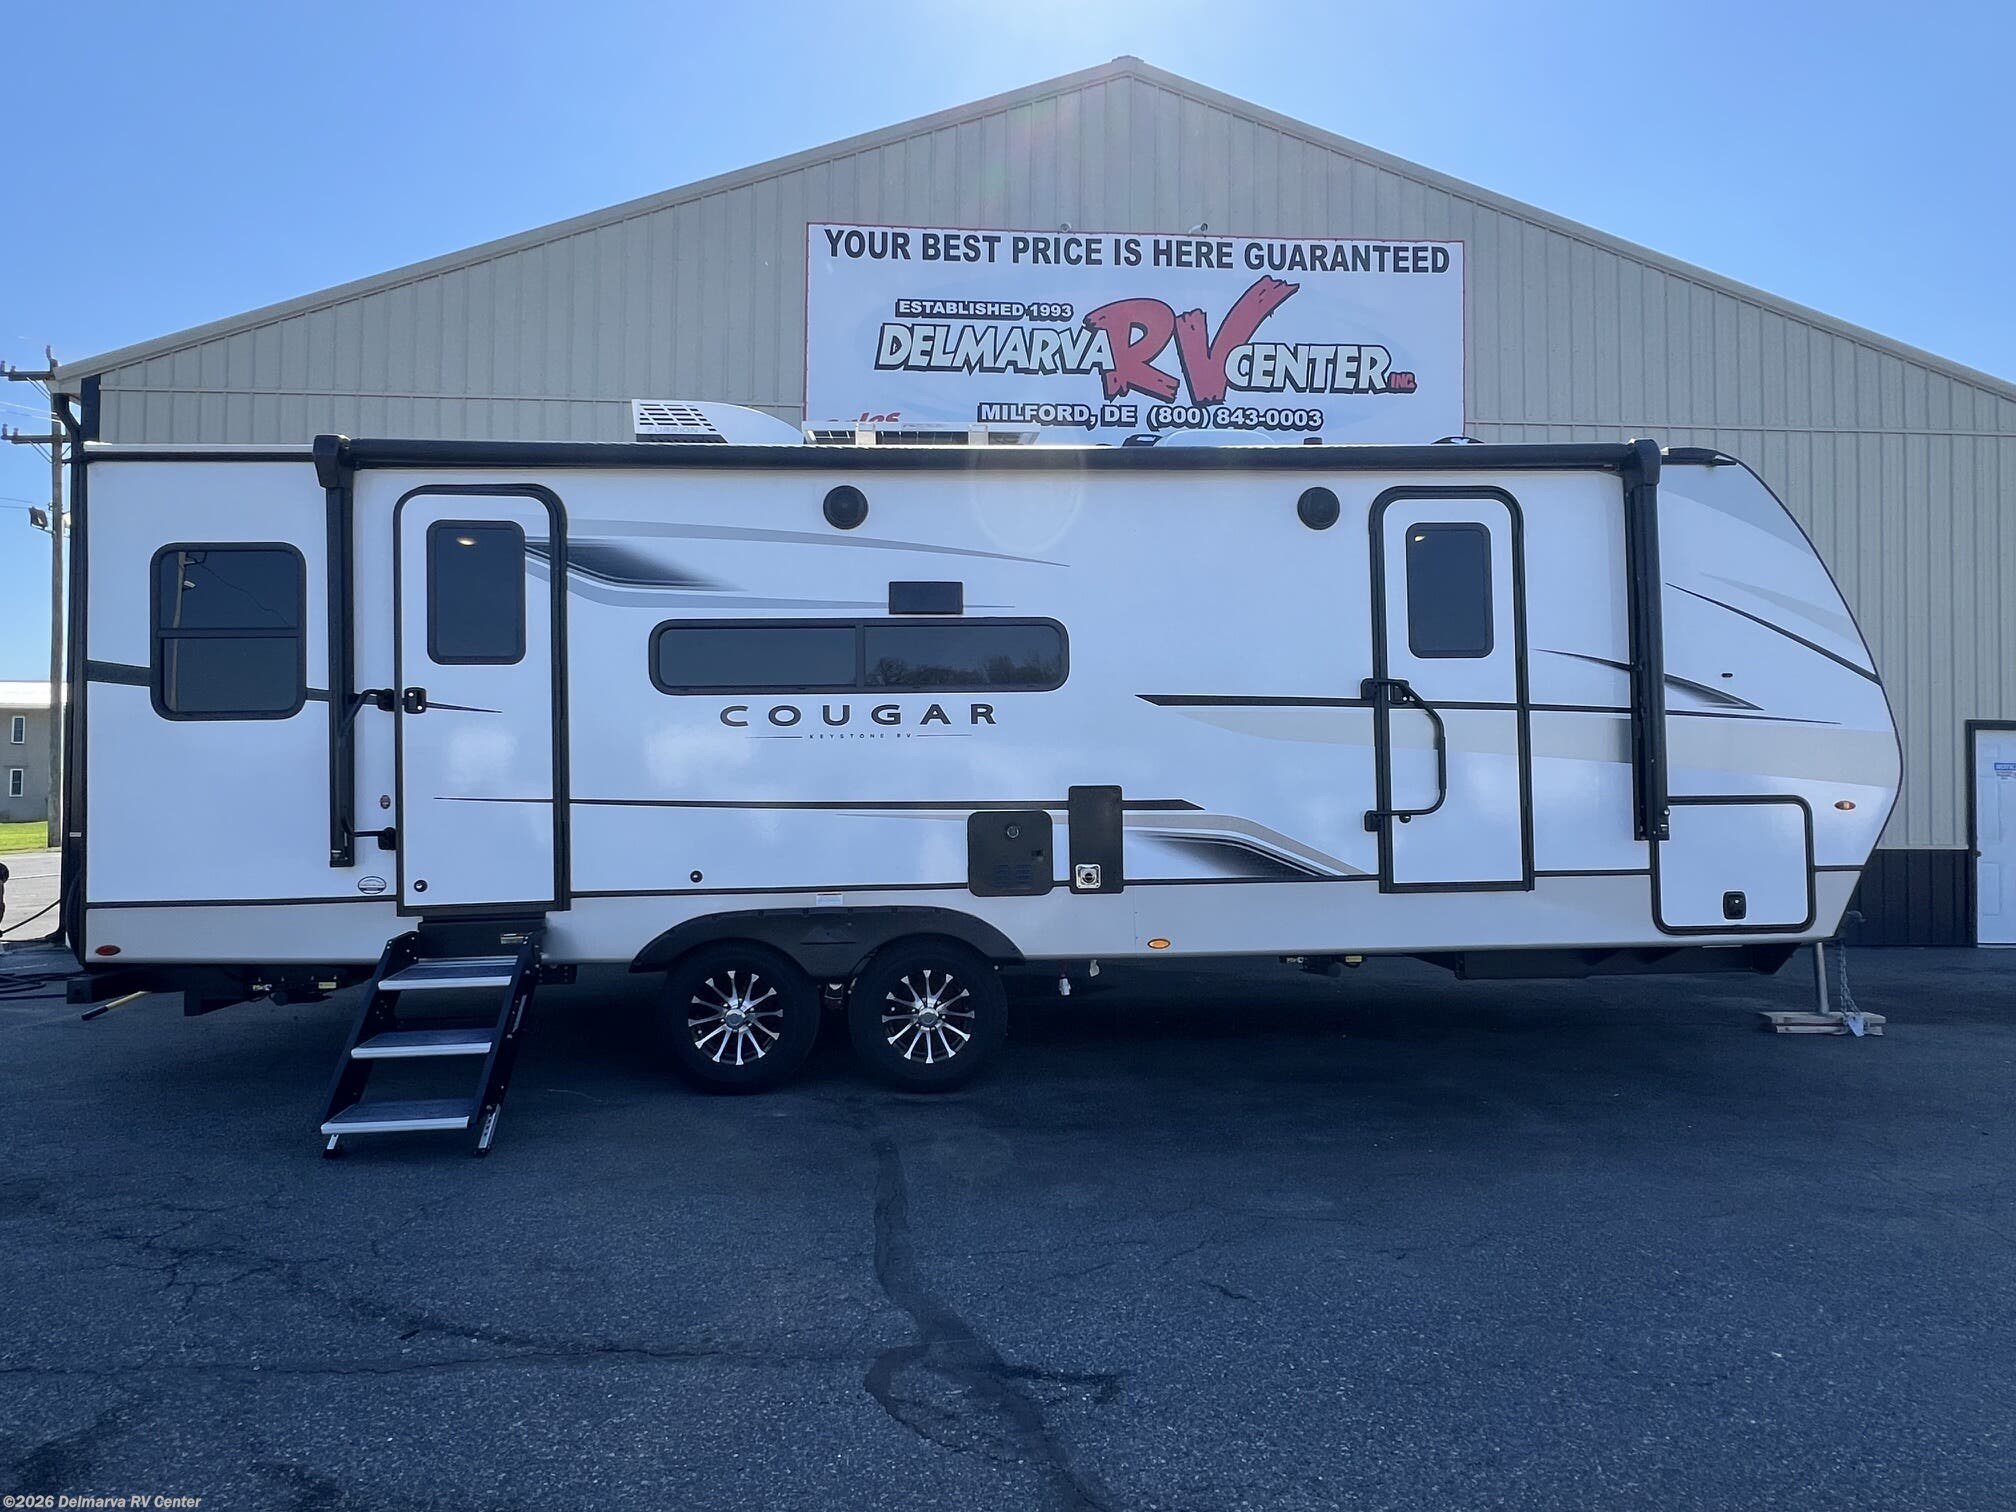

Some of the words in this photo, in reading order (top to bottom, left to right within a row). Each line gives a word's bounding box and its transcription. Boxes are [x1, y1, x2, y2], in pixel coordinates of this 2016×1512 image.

[824, 229, 911, 260] YOUR
[921, 233, 1001, 263] BEST
[1012, 237, 1103, 266] PRICE
[1114, 239, 1142, 266] IS
[1153, 239, 1234, 269] HERE
[1244, 242, 1450, 274] GUARANTEED
[897, 299, 1026, 320] ESTABLISHED
[1027, 304, 1074, 321] 1993
[874, 323, 1117, 375] DELMARVA
[1083, 275, 1300, 408] RV
[1225, 342, 1392, 394] CENTER
[979, 403, 1097, 429] MILFORD,
[1103, 405, 1137, 426] DE
[1147, 407, 1210, 431] (800)
[1214, 409, 1324, 430] 843-0003
[719, 703, 997, 727] COUGAR
